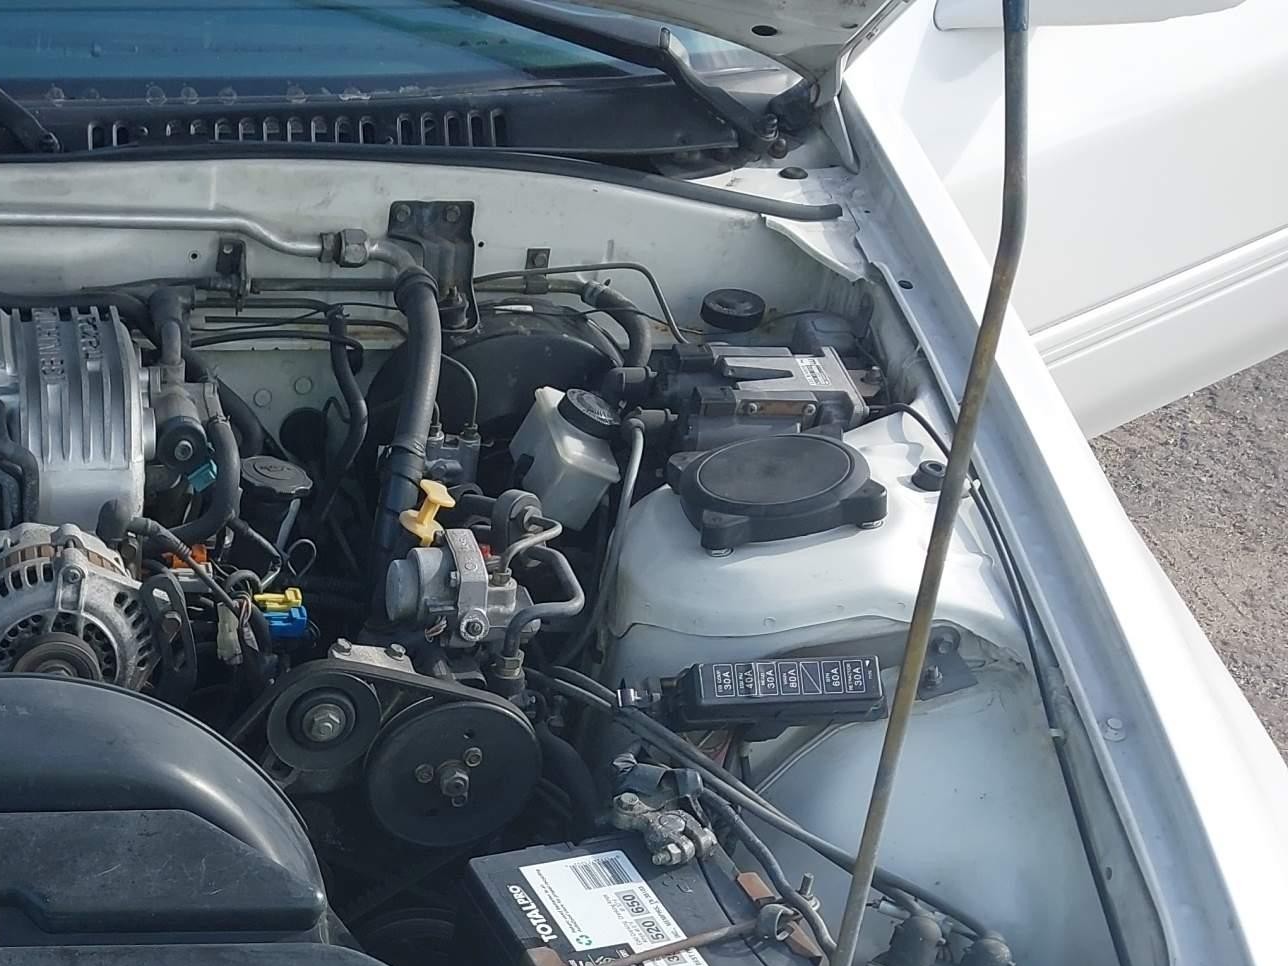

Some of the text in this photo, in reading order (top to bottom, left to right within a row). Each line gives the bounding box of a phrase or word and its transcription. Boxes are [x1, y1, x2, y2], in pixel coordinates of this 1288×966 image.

[722, 671, 732, 690] 30A
[744, 670, 753, 689] 40A
[766, 670, 775, 689] 30A
[788, 669, 798, 689] 80A
[831, 667, 840, 687] 60A
[853, 667, 862, 686] 30A
[507, 884, 559, 943] TOTALPRO
[620, 893, 645, 914] 650
[640, 919, 665, 940] 520
